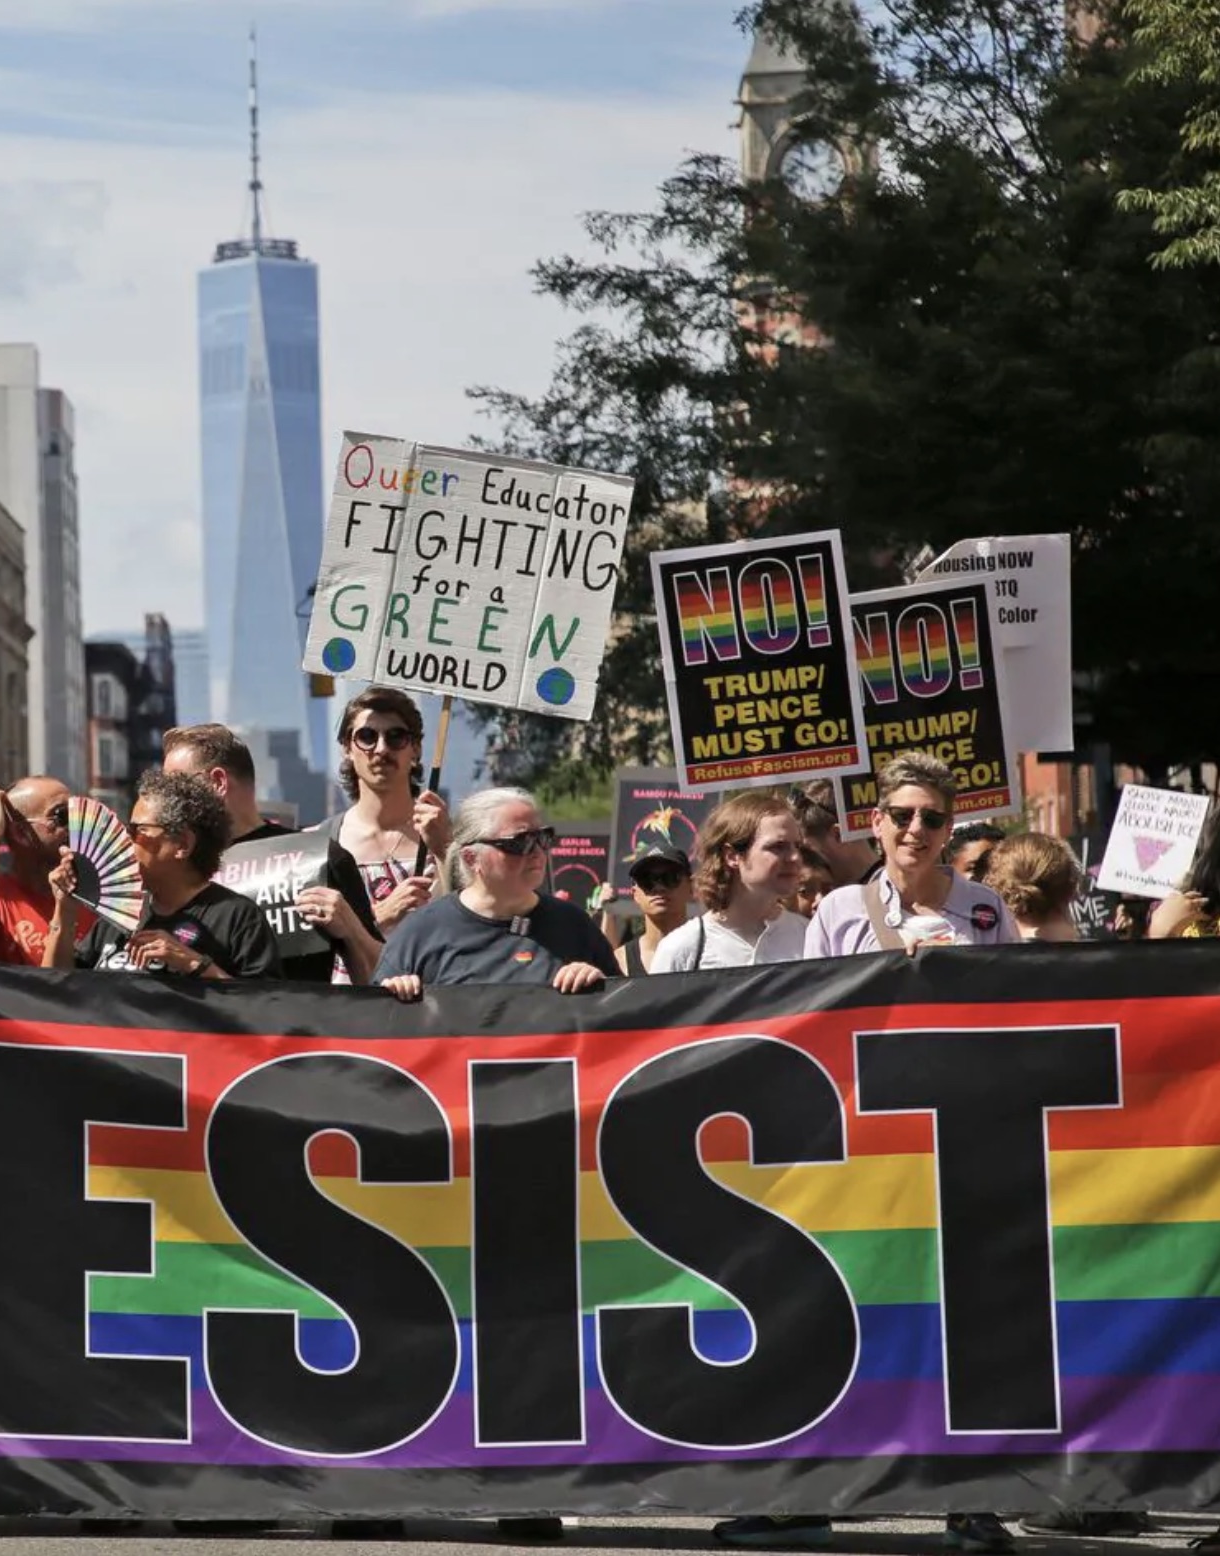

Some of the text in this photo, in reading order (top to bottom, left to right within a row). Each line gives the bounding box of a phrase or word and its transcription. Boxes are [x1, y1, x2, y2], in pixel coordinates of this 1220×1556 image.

[344, 444, 627, 526] Queer Educator
[344, 500, 620, 592] FIGHTING
[997, 551, 1034, 570] NOW
[412, 565, 505, 603] for a
[329, 585, 580, 661] GREEN
[672, 552, 833, 667] NO!
[998, 606, 1038, 624] Color
[386, 648, 508, 693] WORLD
[851, 597, 984, 707] NO!
[702, 663, 826, 700] TRUMP/
[714, 693, 823, 729] PENCE
[865, 707, 978, 747] TRUMP/
[691, 718, 849, 760] MUST GO!
[694, 751, 852, 782] RefuseFascism.org
